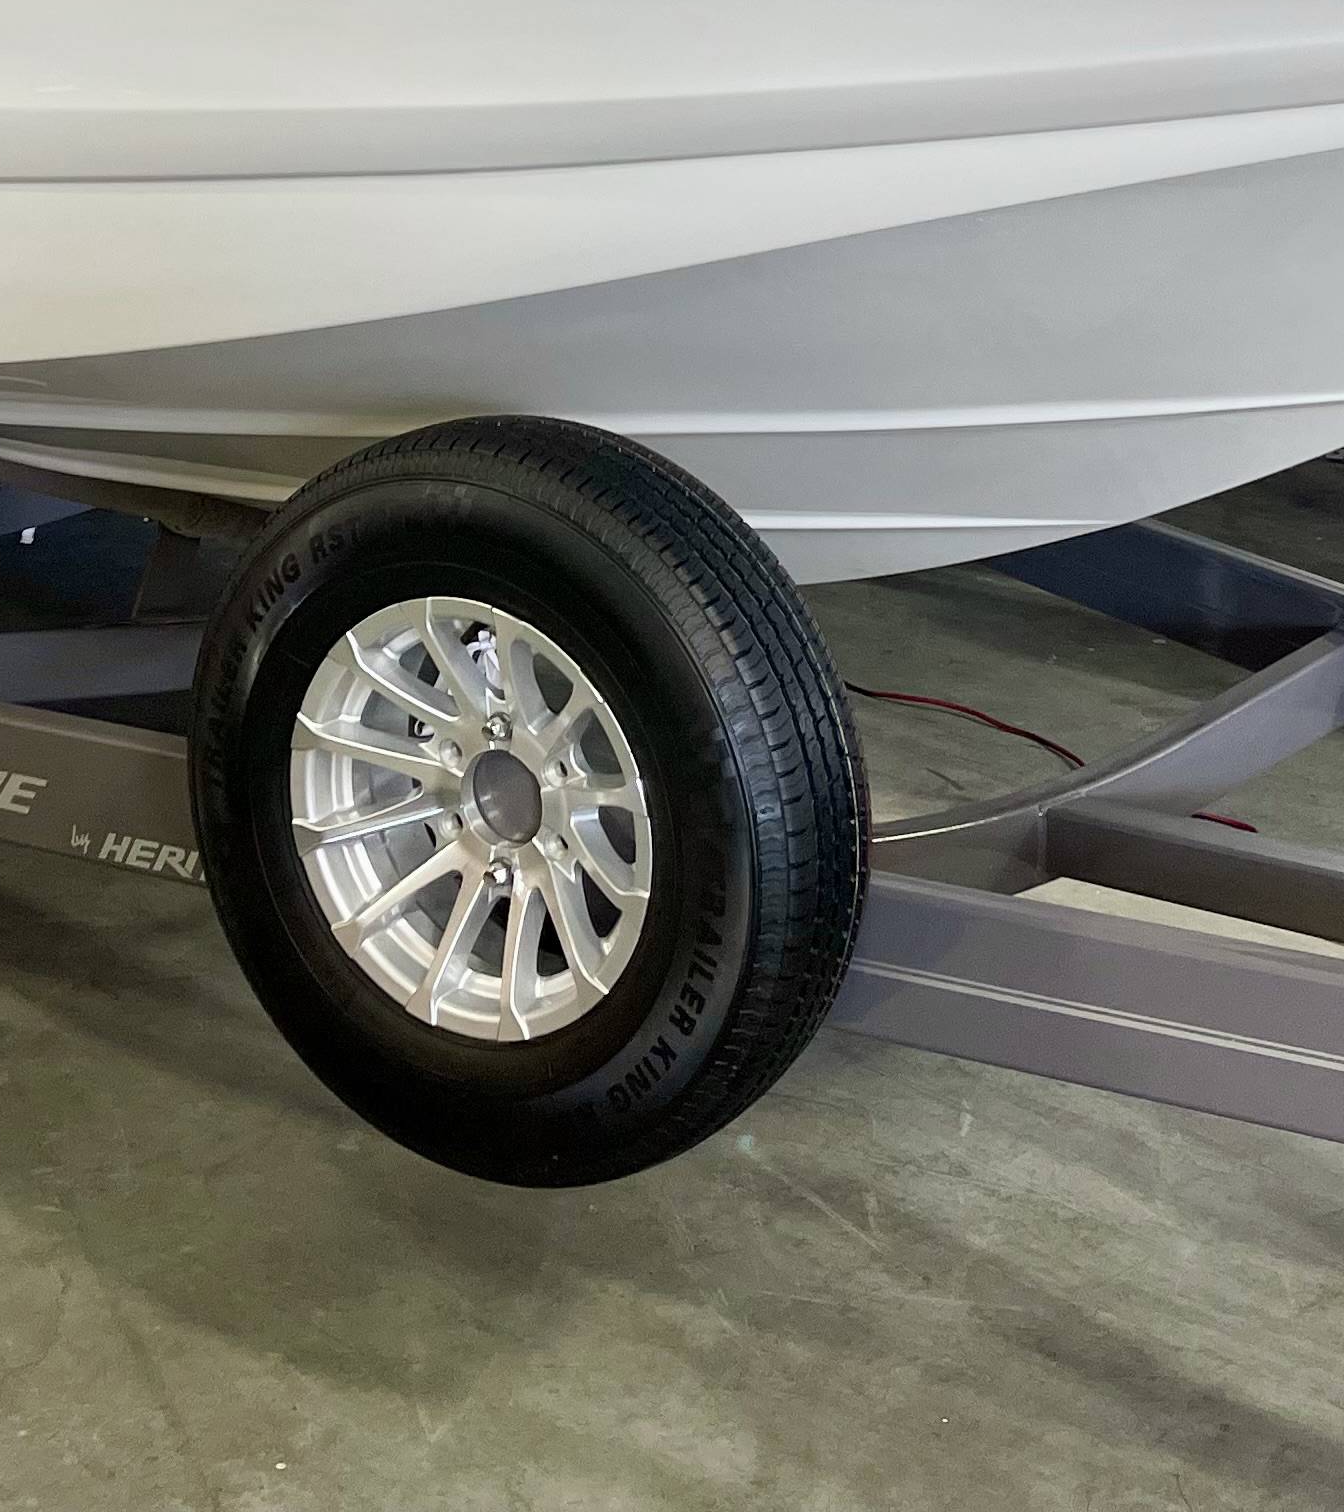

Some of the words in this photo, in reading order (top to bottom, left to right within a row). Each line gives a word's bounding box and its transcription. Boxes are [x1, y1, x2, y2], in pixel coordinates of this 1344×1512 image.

[246, 553, 303, 634] KING
[70, 824, 91, 855] by
[98, 832, 206, 883] HERI
[606, 1035, 678, 1113] KING
